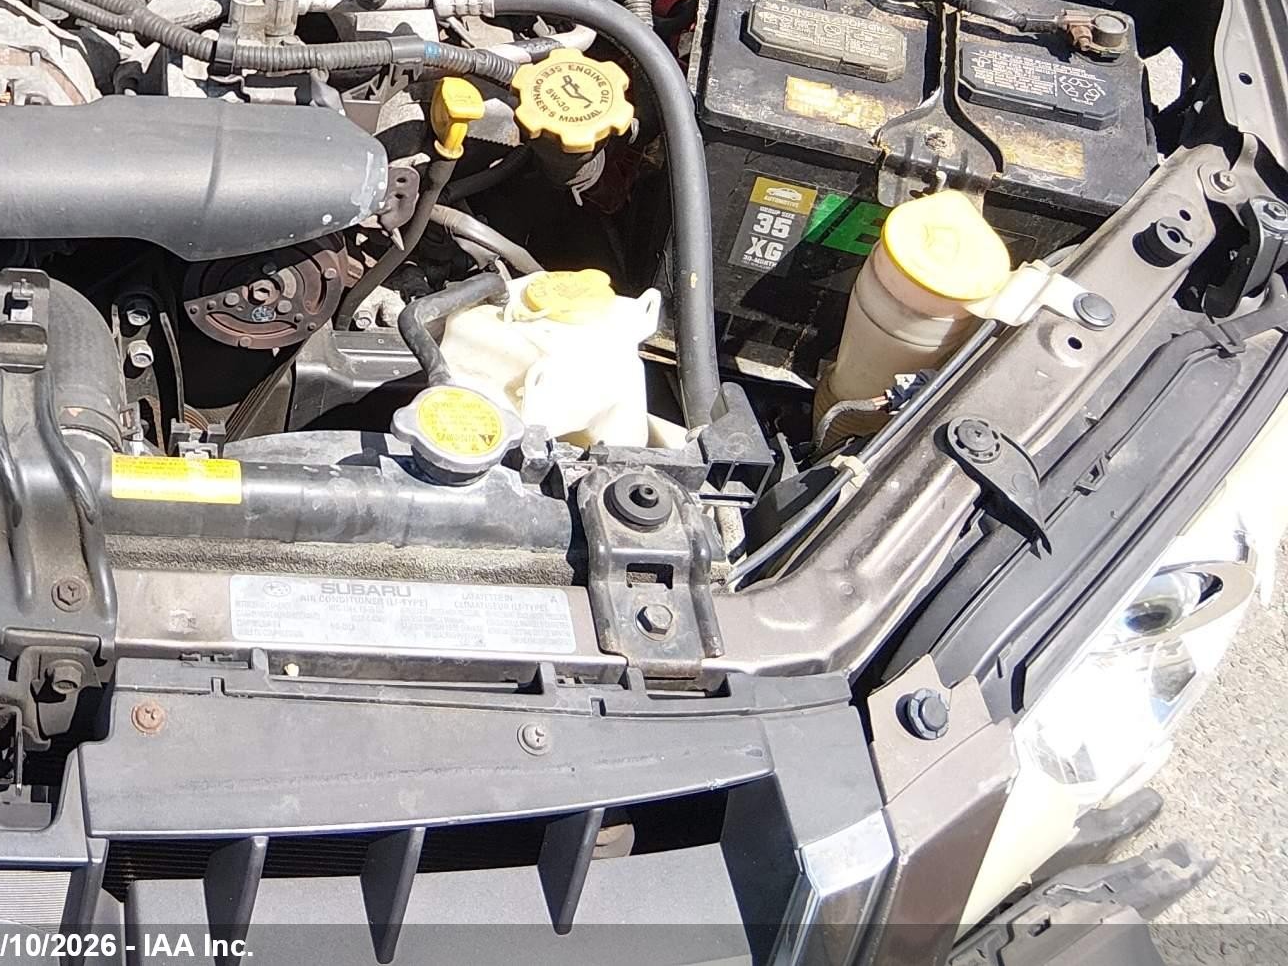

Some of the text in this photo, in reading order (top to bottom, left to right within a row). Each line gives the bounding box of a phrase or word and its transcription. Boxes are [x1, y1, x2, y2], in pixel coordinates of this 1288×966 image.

[532, 65, 602, 123] SEE OWNER'S MANUAL
[567, 64, 610, 105] ENGINE OIL
[545, 88, 570, 112] 5W-30
[753, 212, 793, 239] 35
[744, 236, 784, 261] XG
[300, 594, 316, 603] AIR
[318, 595, 384, 606] CONDITIONER
[320, 583, 412, 598] SUBARU
